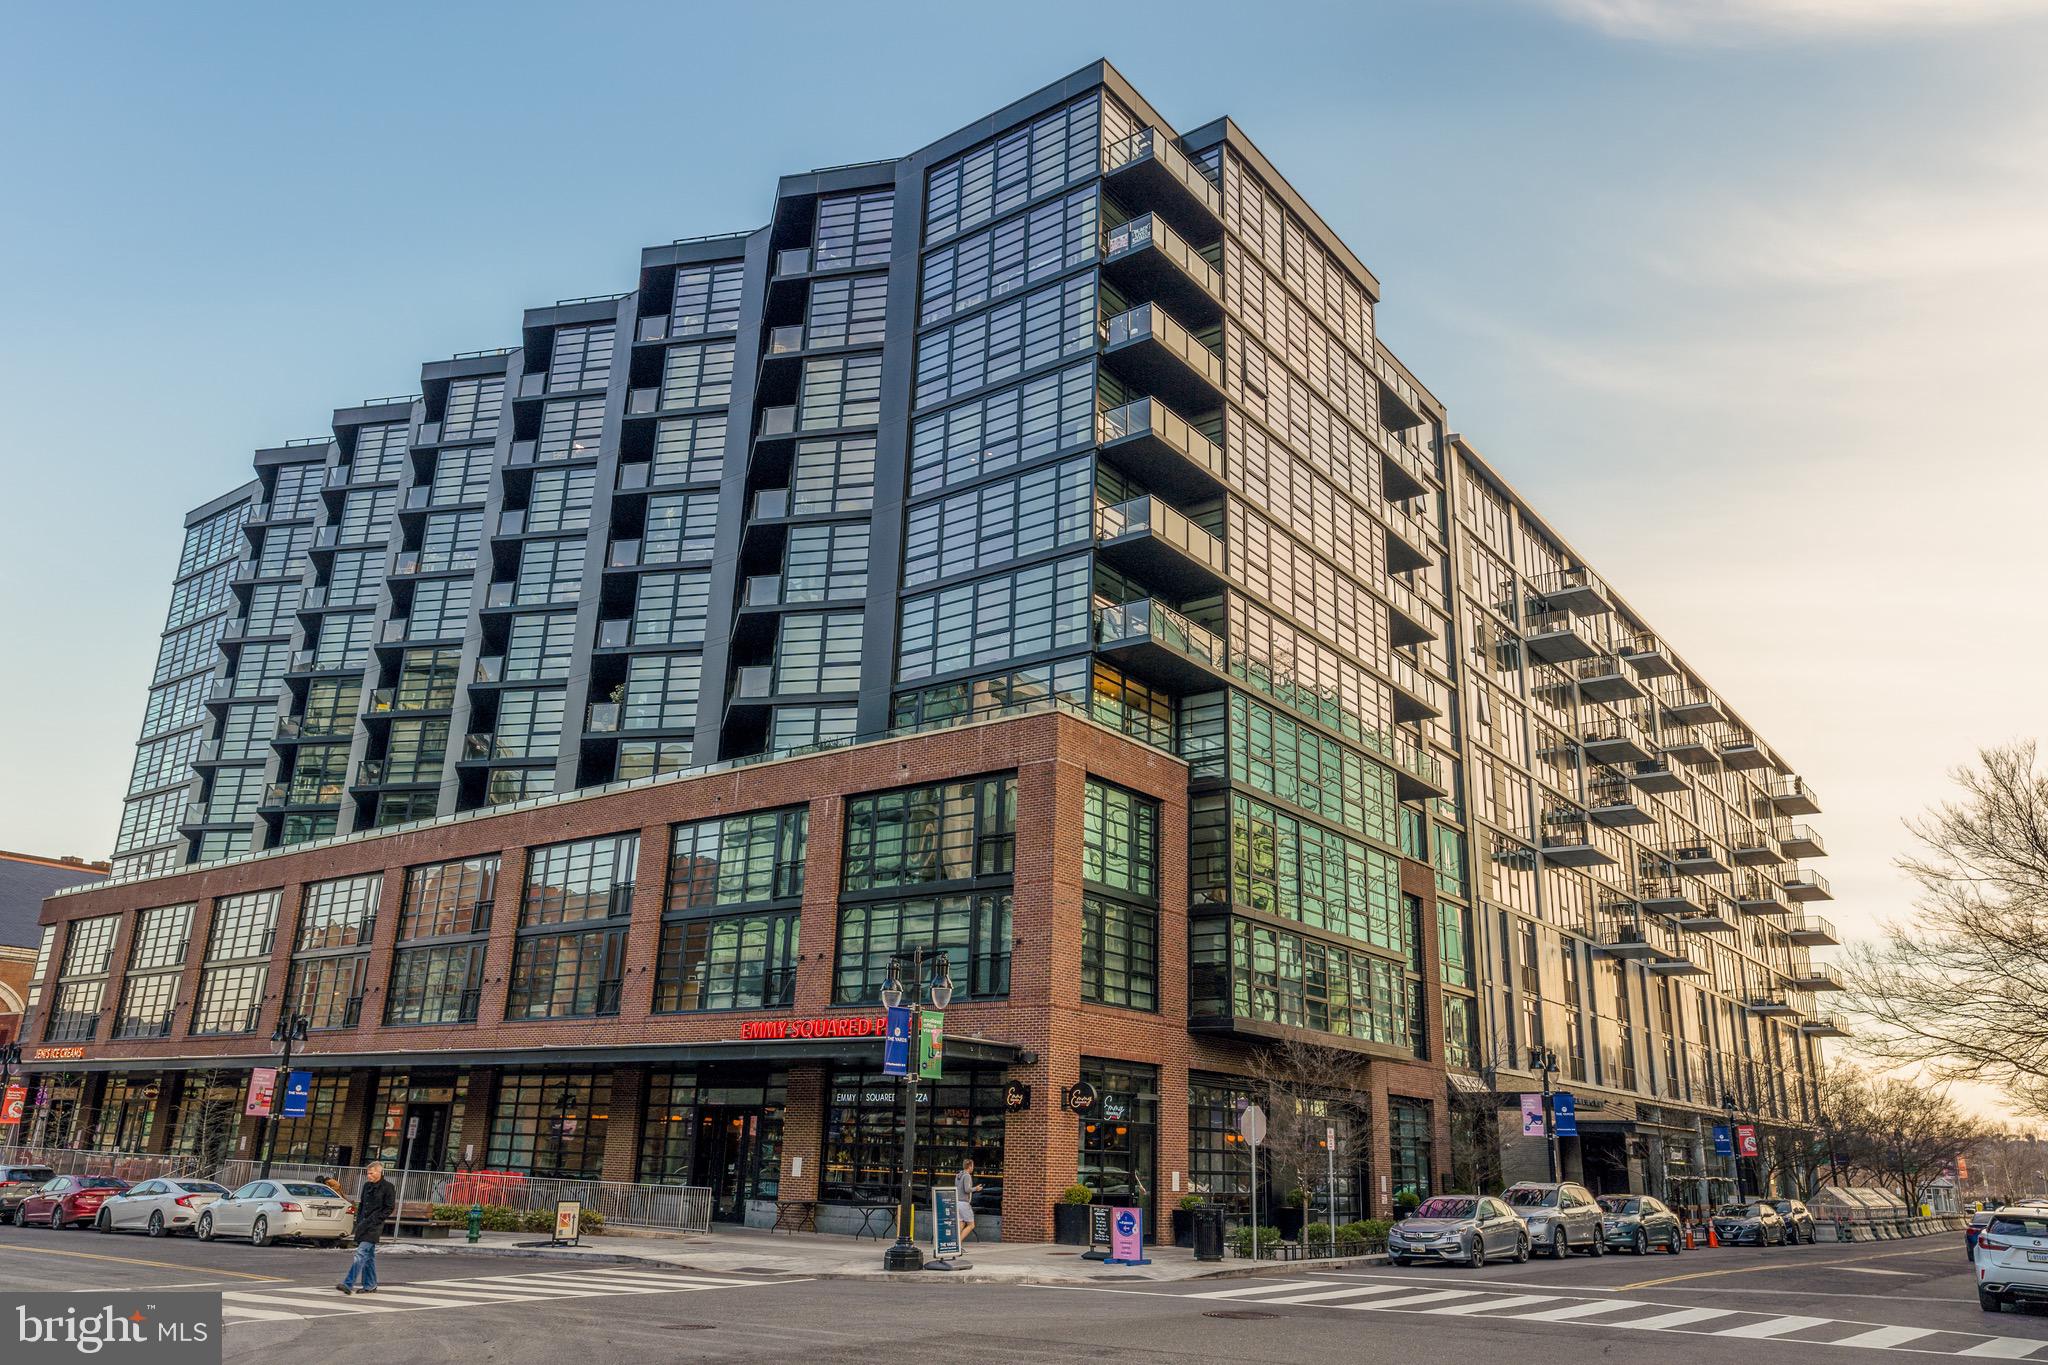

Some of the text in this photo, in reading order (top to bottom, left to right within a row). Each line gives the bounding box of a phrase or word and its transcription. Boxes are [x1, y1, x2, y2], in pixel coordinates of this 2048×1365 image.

[741, 1020, 787, 1040] EMMY
[790, 1017, 873, 1039] SQUARED
[836, 1093, 856, 1102] EMMY
[1070, 1089, 1092, 1108] Emmy
